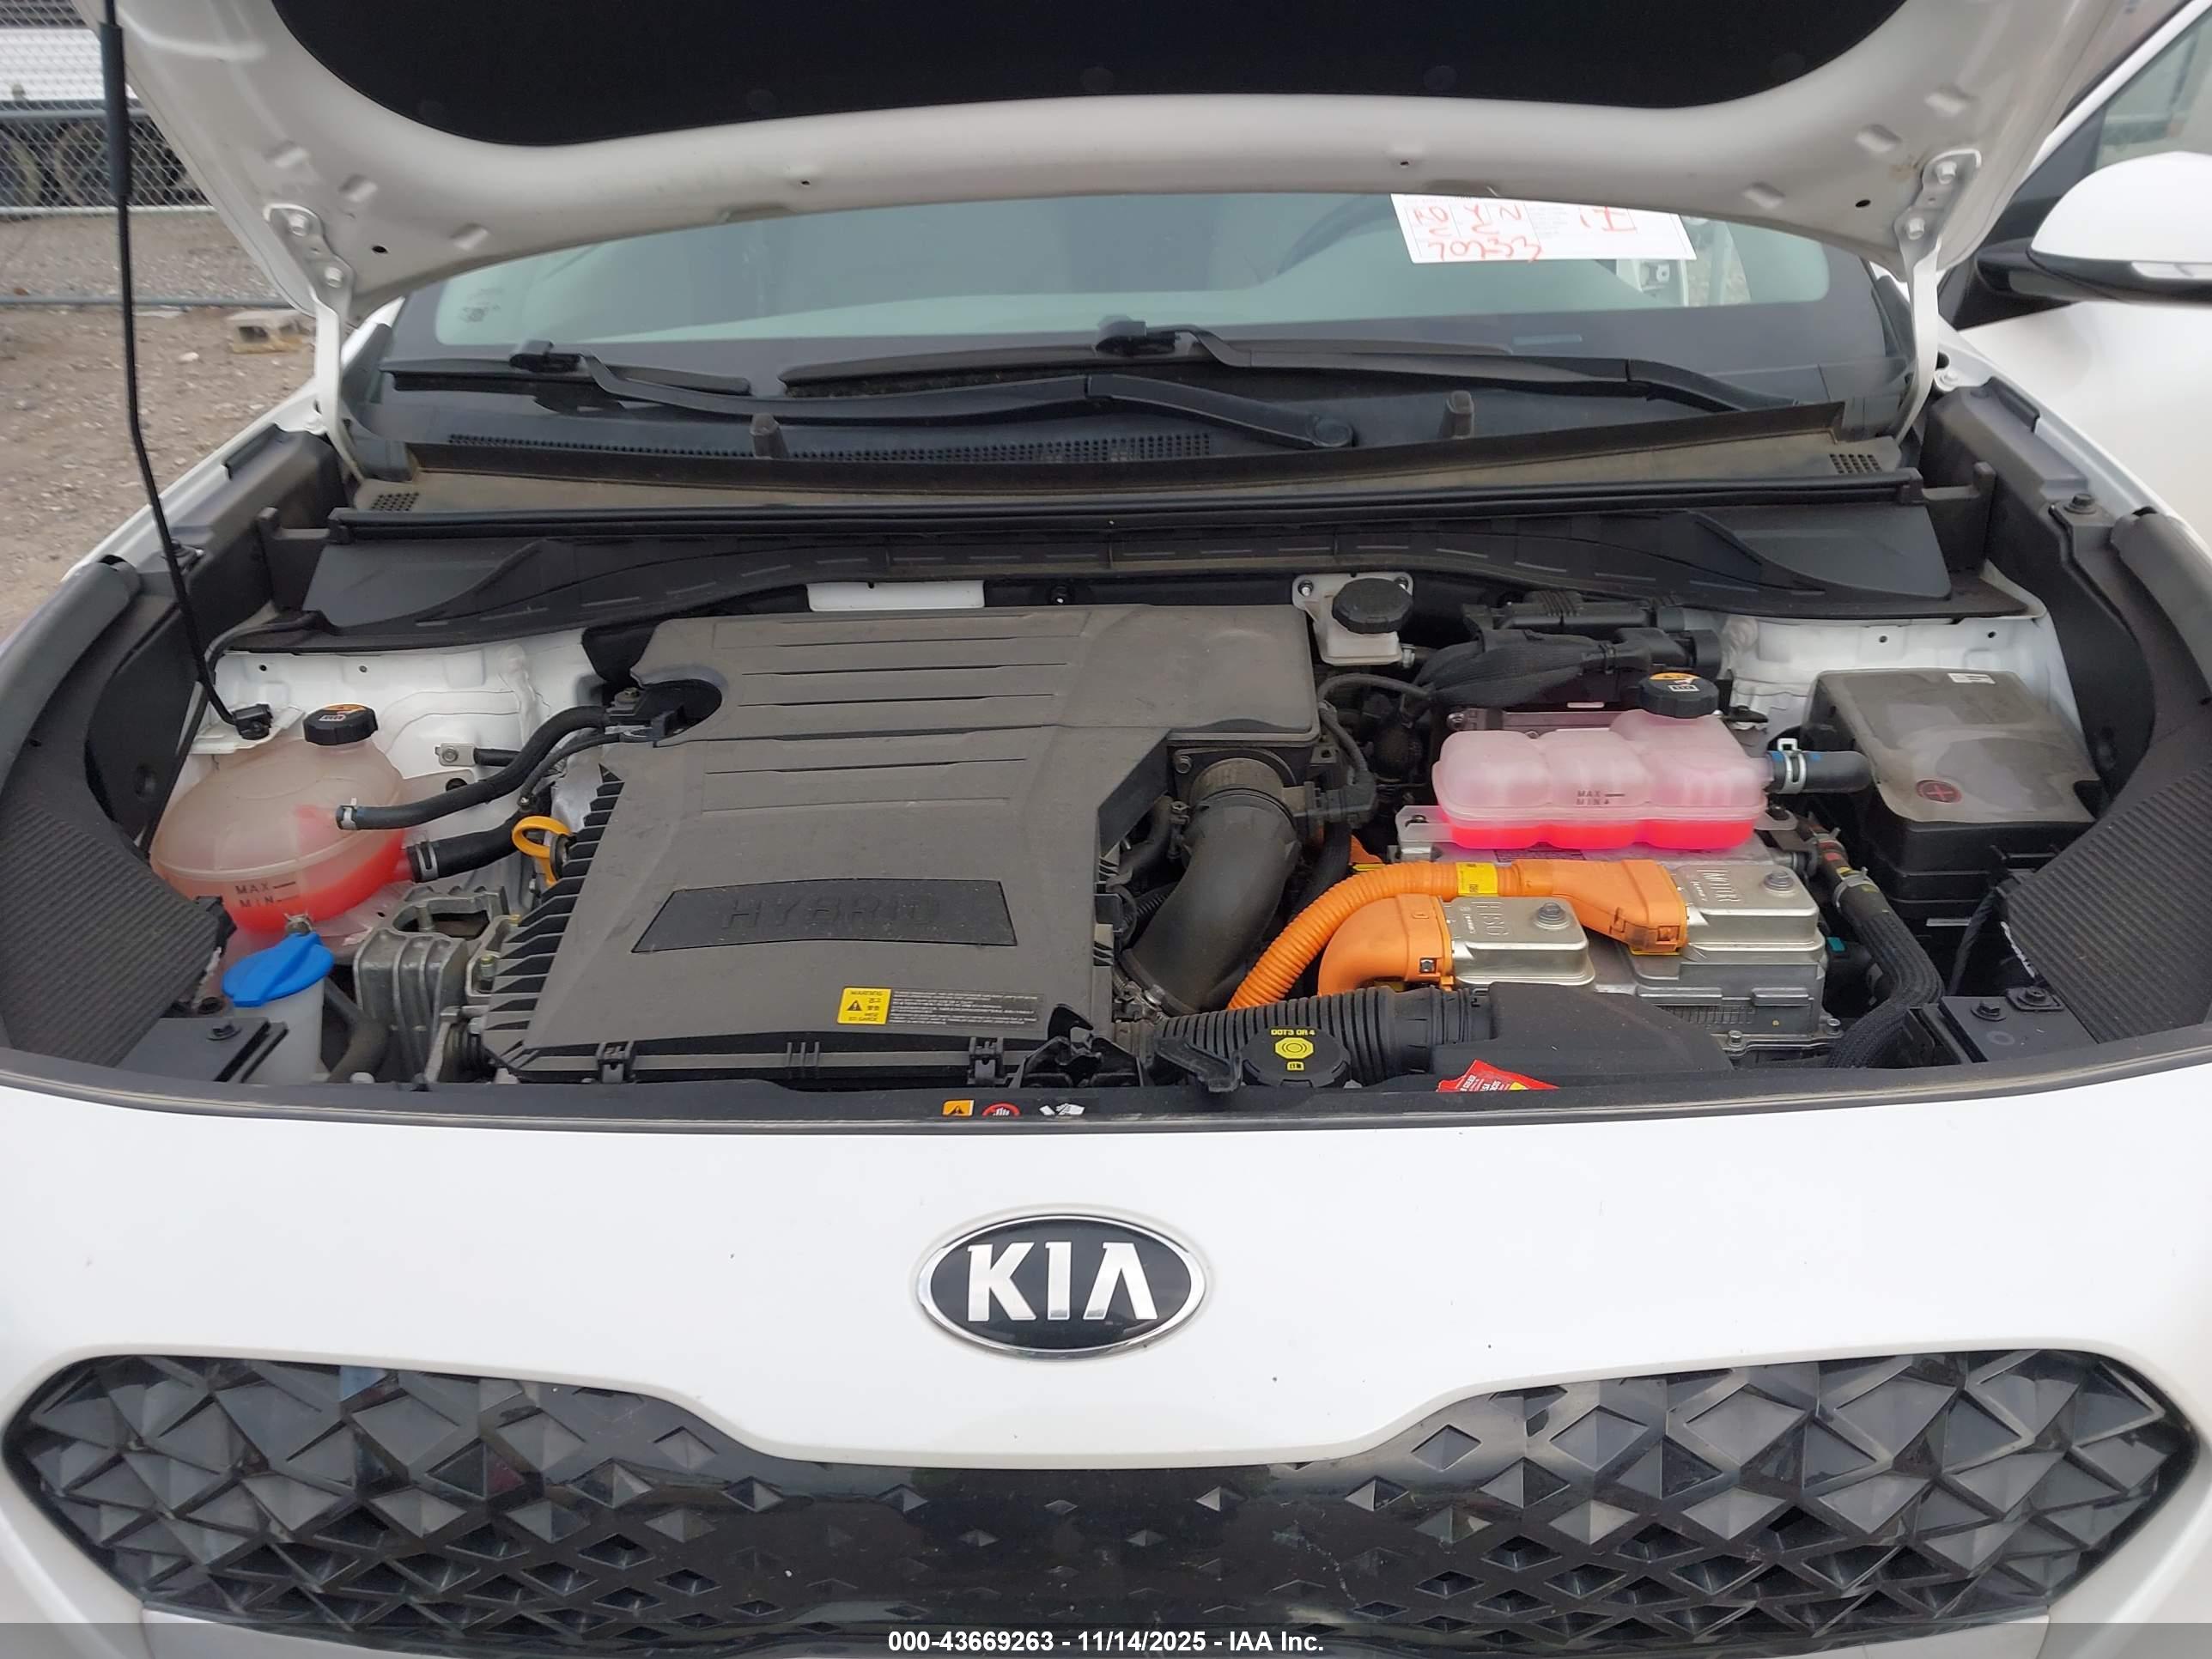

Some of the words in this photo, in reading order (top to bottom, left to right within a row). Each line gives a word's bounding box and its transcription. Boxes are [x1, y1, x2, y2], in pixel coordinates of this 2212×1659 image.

[1577, 789, 1601, 798] MAX
[234, 881, 270, 894] MAX
[239, 896, 275, 908] MIN
[721, 894, 940, 930] HYBRID
[967, 1242, 1158, 1322] KIA
